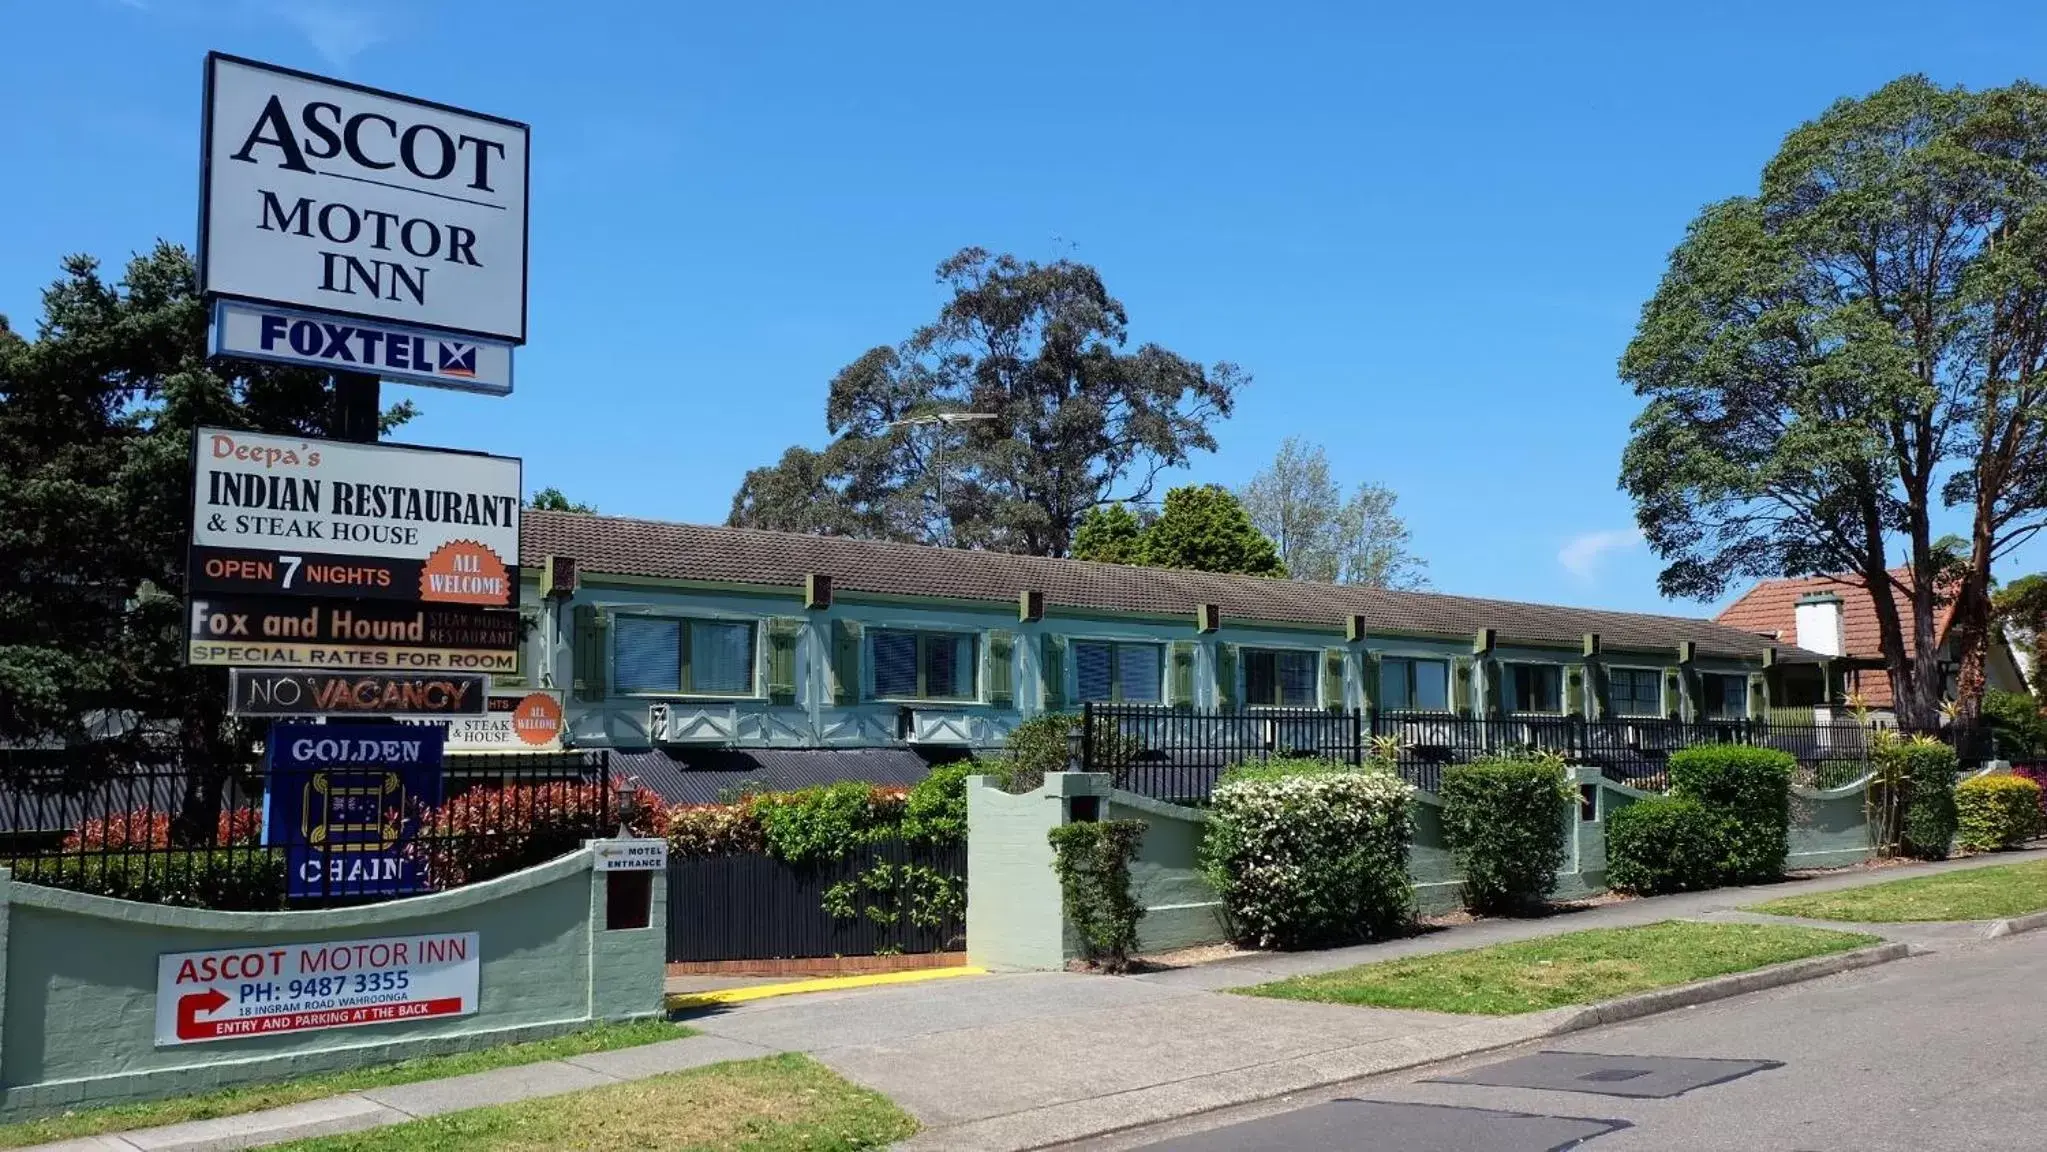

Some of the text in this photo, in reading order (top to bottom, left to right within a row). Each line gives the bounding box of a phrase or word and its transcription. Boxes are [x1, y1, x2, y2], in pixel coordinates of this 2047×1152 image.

[230, 95, 506, 192] ASCOT
[256, 189, 484, 268] MOTOR
[318, 251, 430, 305] INN
[260, 314, 433, 373] FOXTEL
[210, 434, 321, 468] Deepa's
[207, 470, 516, 527] INDIAN RESTAURANT
[207, 513, 418, 545] & STEAK HOUSE
[205, 555, 391, 589] OPEN 7 NIGHTS
[453, 554, 481, 573] ALL
[429, 574, 503, 596] WELCOME
[191, 601, 424, 641] Fox and Hound
[429, 629, 515, 645] RESTAURANT
[192, 646, 513, 668] SPECIAL RATES FOR ROOM
[251, 677, 470, 709] NO VACANCY
[489, 700, 509, 709] HTS
[531, 706, 544, 717] ALL
[453, 729, 462, 738] &
[464, 720, 510, 731] STEAK
[518, 718, 557, 730] WELCOME
[464, 731, 510, 743] HOUSE
[292, 739, 422, 762] GOLDEN
[300, 858, 404, 882] CHAIN
[608, 859, 662, 868] ENTRANCE
[176, 938, 466, 984] ASCOT MOTOR INN
[240, 970, 409, 1004] PH: 9487 3355
[239, 992, 409, 1016] 18 INGRAM ROAD WAHROONGA
[216, 1004, 429, 1035] ENTRY AND PARKING AT THE BACK
